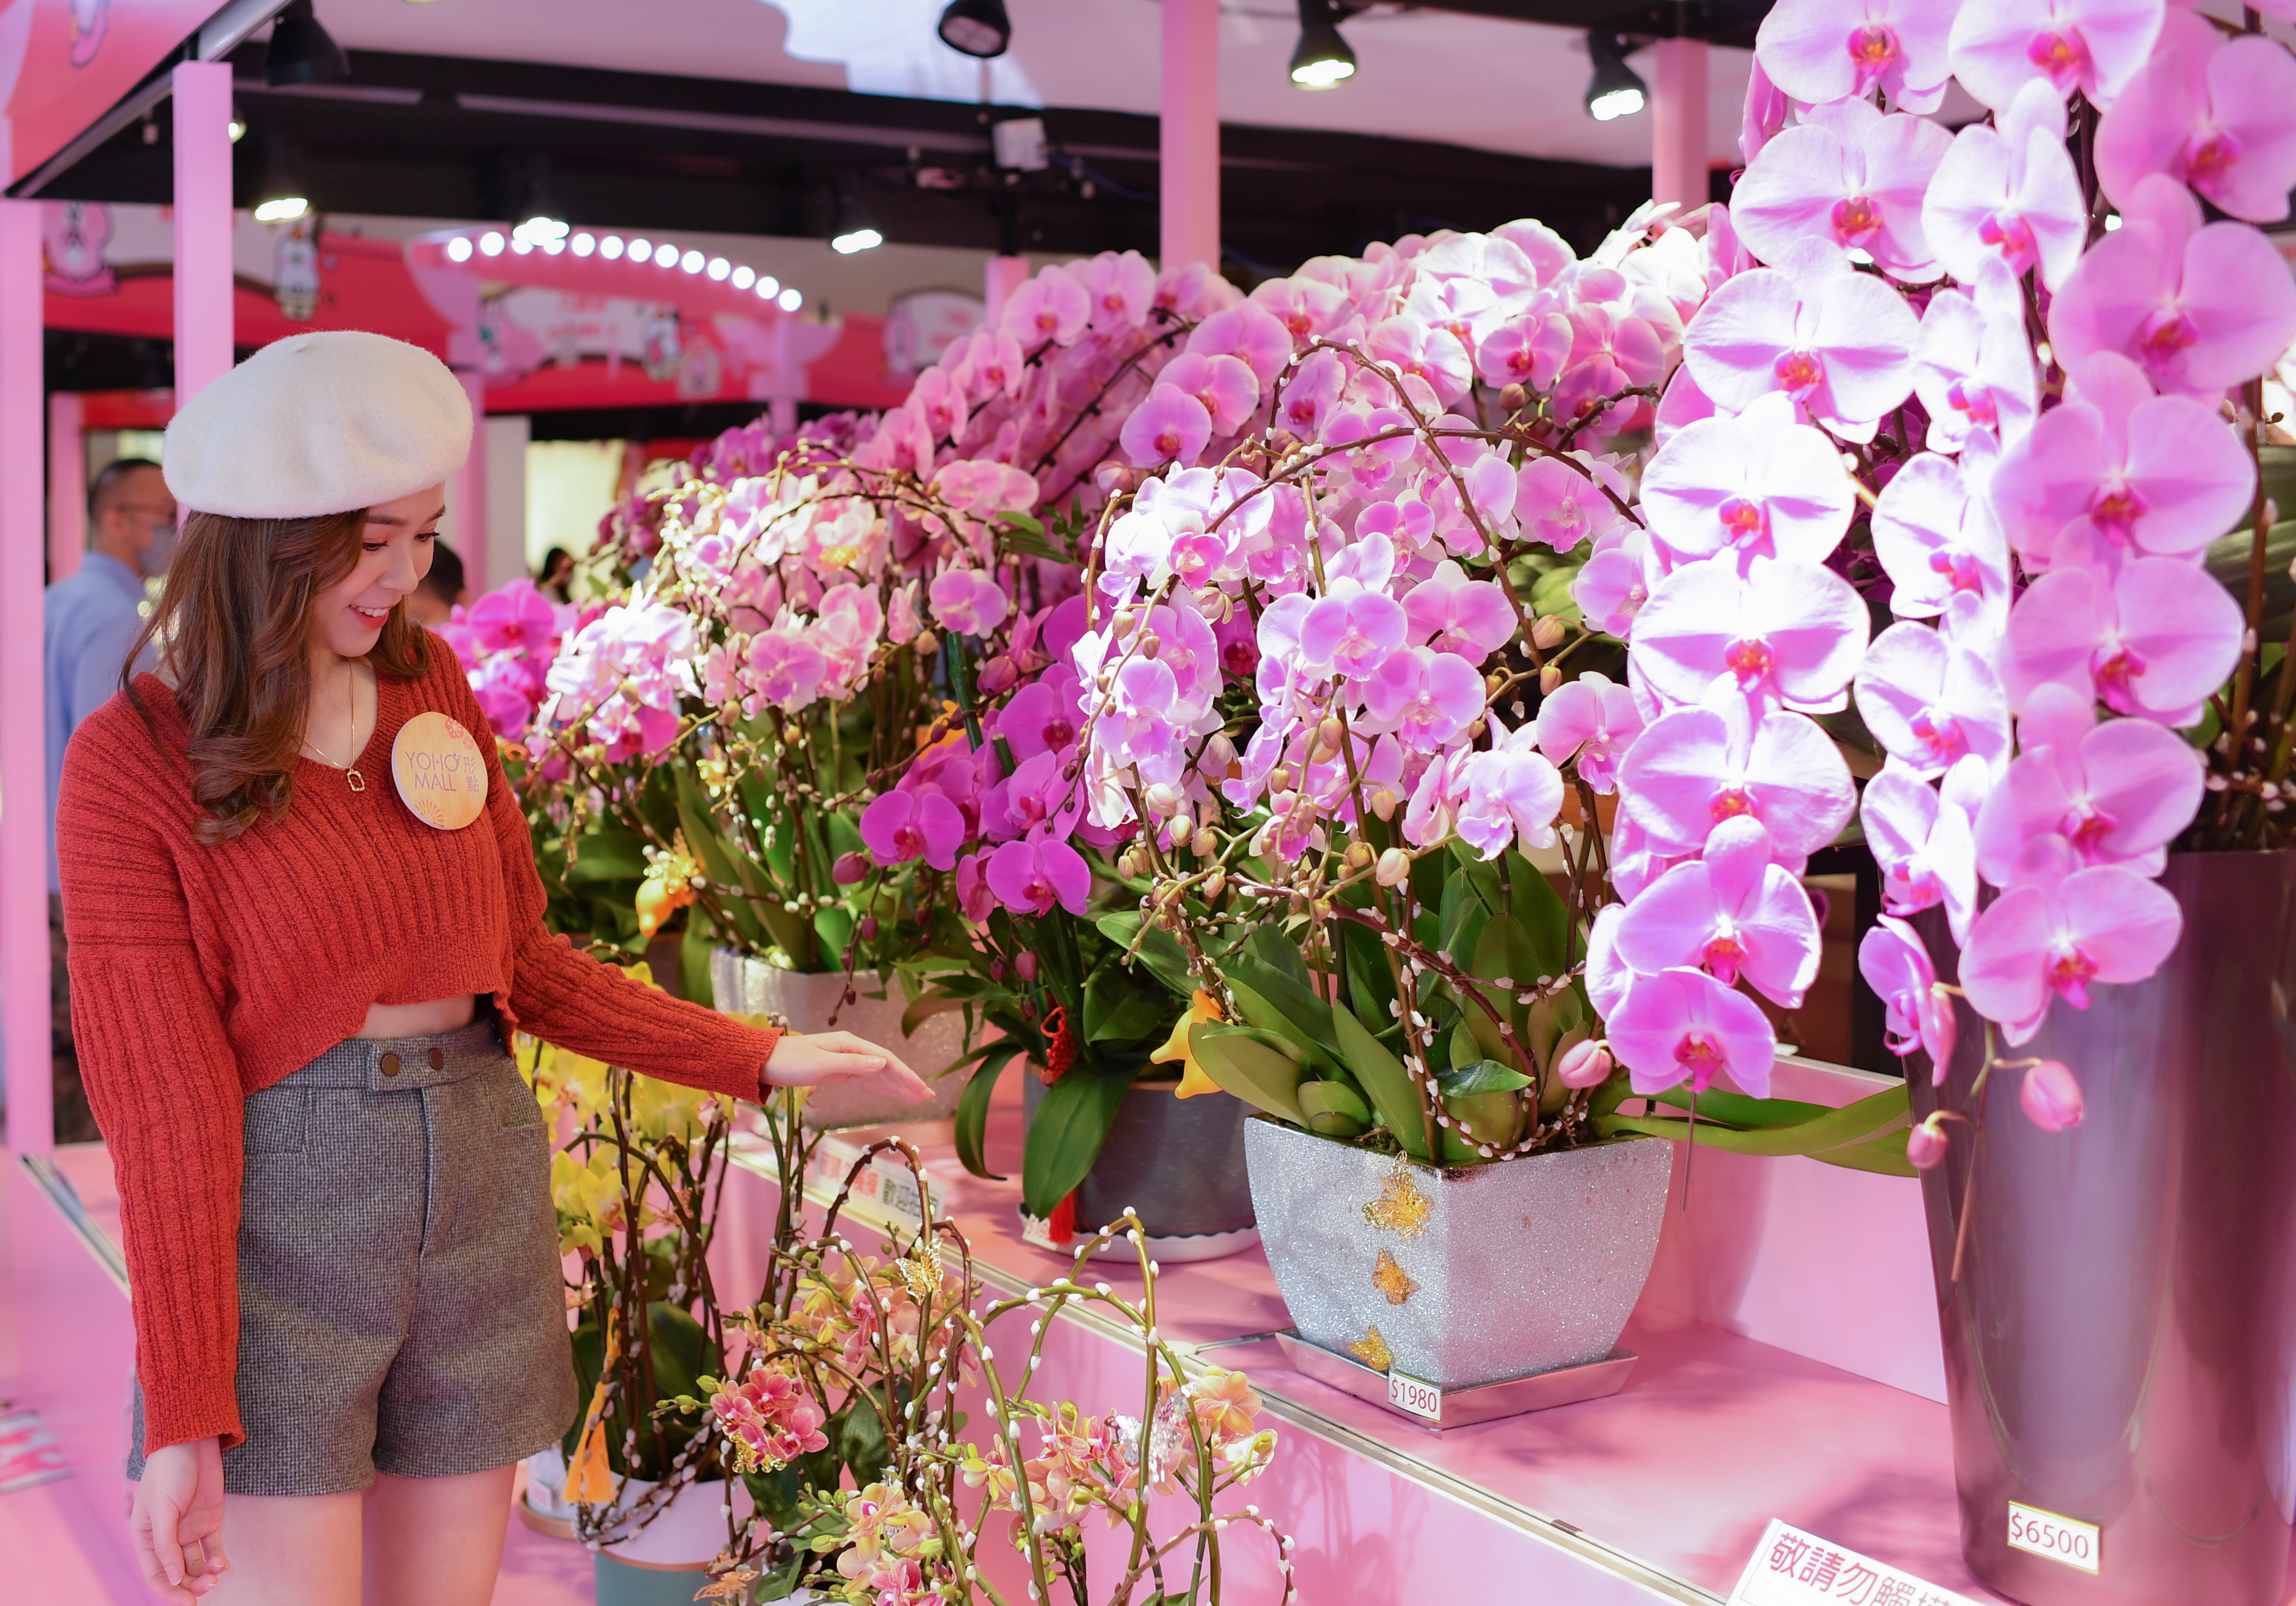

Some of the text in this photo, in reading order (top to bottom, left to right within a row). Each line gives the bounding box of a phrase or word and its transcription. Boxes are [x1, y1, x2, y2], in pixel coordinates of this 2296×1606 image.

[405, 751, 460, 772] YOHO
[462, 756, 479, 792] 形點
[415, 771, 457, 791] MALL
[1391, 1377, 1437, 1413] $1980
[2011, 1512, 2088, 1559] $6500
[1770, 1532, 1955, 1606] 敬請勿觸
